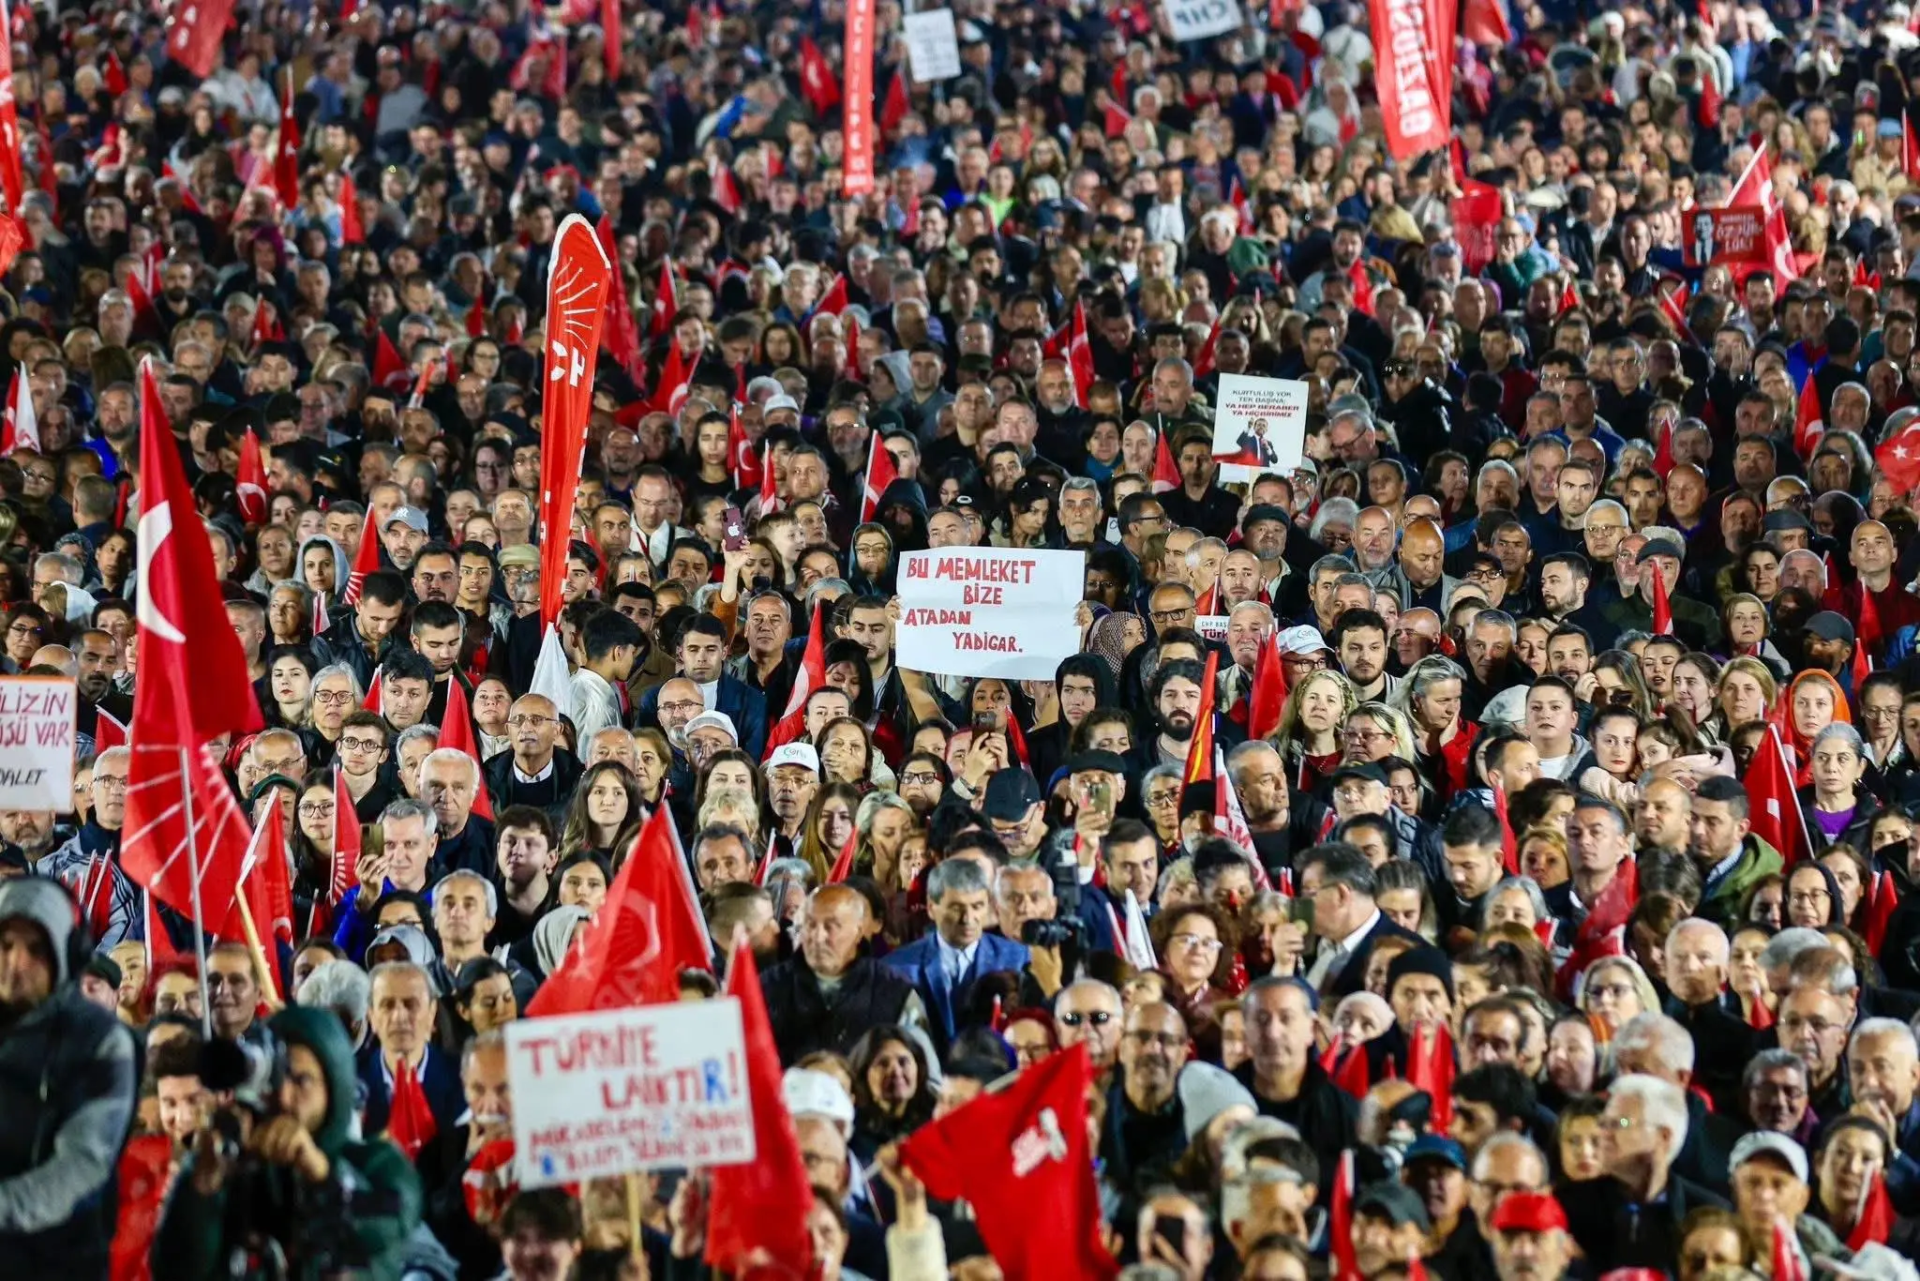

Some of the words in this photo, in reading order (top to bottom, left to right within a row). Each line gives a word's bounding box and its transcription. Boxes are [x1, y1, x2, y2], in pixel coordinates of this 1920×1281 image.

[906, 557, 929, 579] BU
[935, 557, 1036, 584] MEMLEKET
[963, 582, 1003, 605] BİZE
[904, 608, 971, 627] ATADAN
[952, 631, 1023, 653] YADİGAR.
[35, 721, 69, 748] VAR
